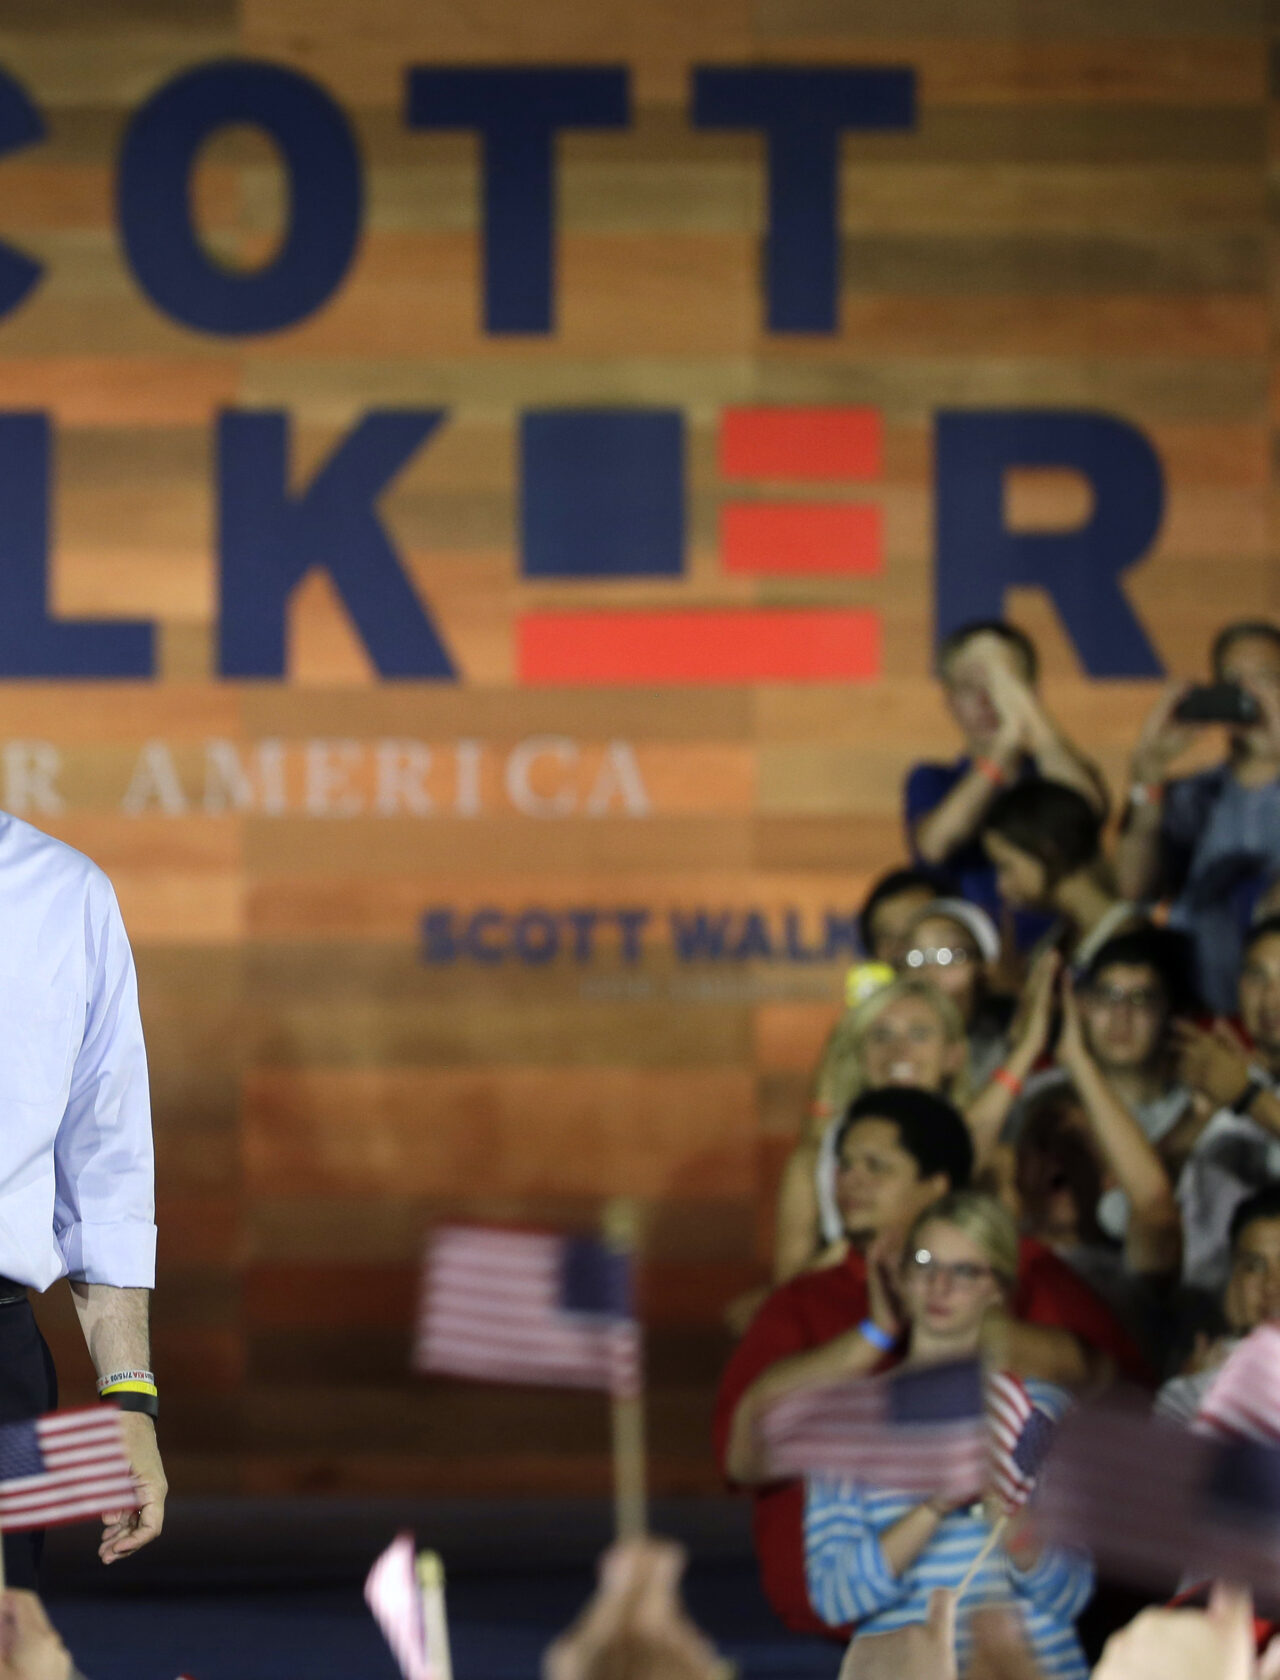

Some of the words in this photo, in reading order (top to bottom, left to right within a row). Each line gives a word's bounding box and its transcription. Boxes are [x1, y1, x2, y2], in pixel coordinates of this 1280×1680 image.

[127, 736, 651, 818] AMERICA
[423, 908, 649, 966] SCOTT
[668, 908, 866, 966] WALK
